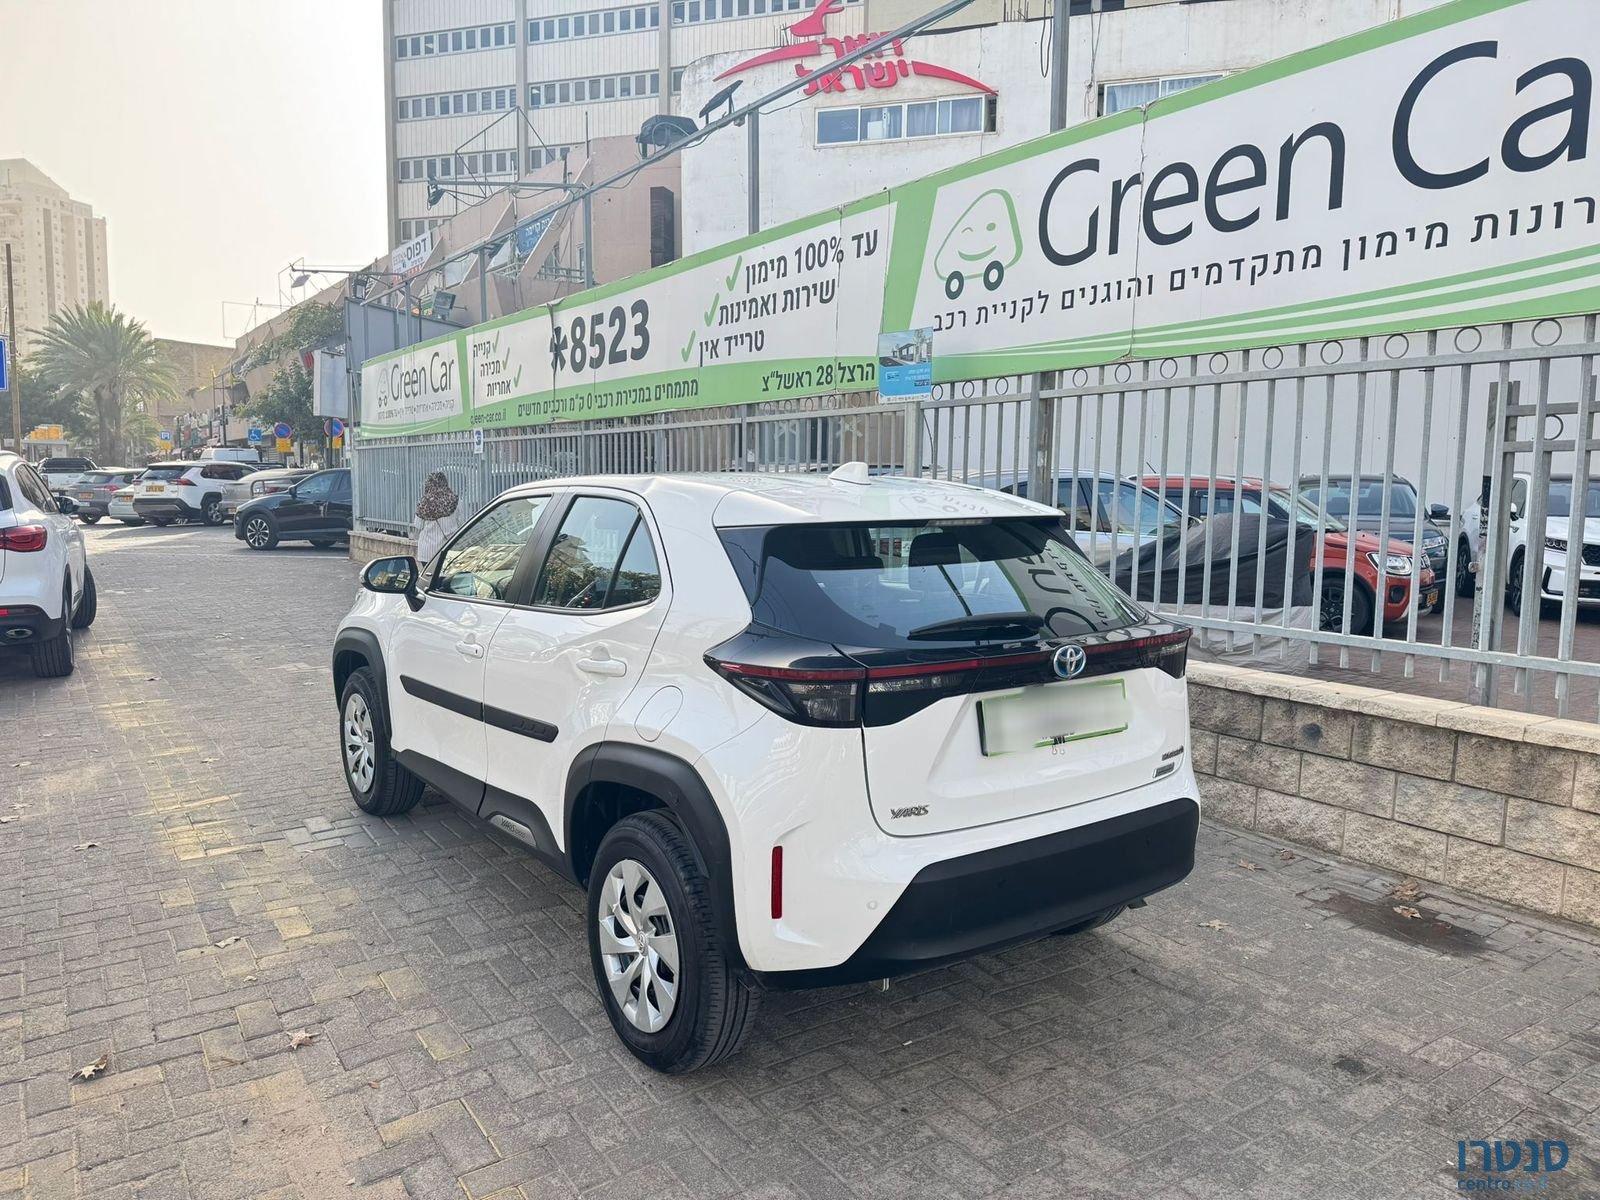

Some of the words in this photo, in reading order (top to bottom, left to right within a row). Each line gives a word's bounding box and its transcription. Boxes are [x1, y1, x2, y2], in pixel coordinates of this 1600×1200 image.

[1038, 121, 1345, 267] Green
[794, 235, 845, 274] 100%
[851, 229, 878, 259] עד
[1342, 221, 1449, 271] מימון
[745, 255, 788, 294] מימון
[1169, 244, 1322, 292] מתקדמים
[781, 278, 836, 313] שירות
[1061, 274, 1154, 310] והוגנים
[718, 292, 777, 326] ואמינות
[975, 290, 1050, 323] לקניית
[933, 310, 967, 332] רכב
[473, 340, 491, 359] קנייה
[699, 338, 720, 367] אין
[724, 329, 765, 357] טרייד
[390, 363, 427, 401] Green
[430, 351, 455, 394] Car
[480, 359, 501, 377] מכירה
[816, 364, 834, 386] 28
[837, 362, 875, 384] הרצל
[486, 379, 512, 398] אחריות
[587, 392, 592, 410] 0
[597, 391, 614, 409] רכבי
[616, 386, 651, 406] במכירת
[654, 379, 698, 401] מתמחים
[518, 401, 541, 417] חדשים
[543, 397, 568, 415] ורכבים
